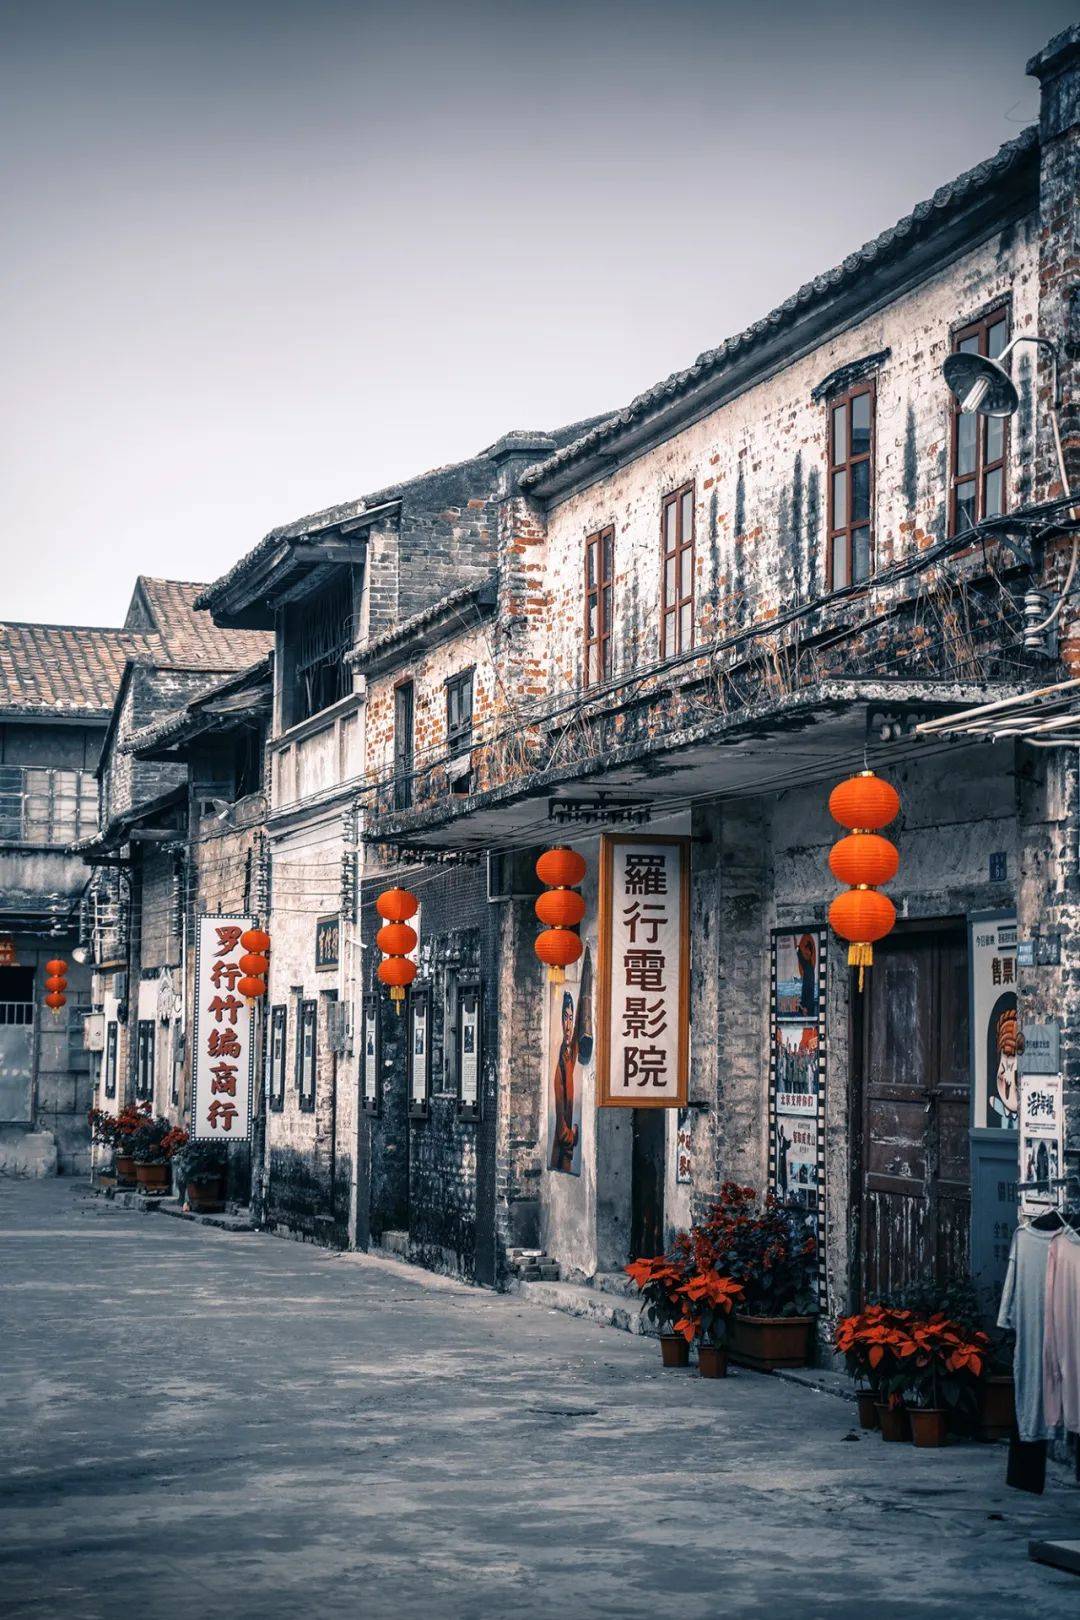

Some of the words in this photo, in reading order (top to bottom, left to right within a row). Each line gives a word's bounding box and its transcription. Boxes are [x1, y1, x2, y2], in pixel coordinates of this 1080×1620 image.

[207, 926, 244, 1131] 罗行竹编商行
[622, 854, 668, 1087] 羅行電影院
[991, 957, 1017, 986] 售票
